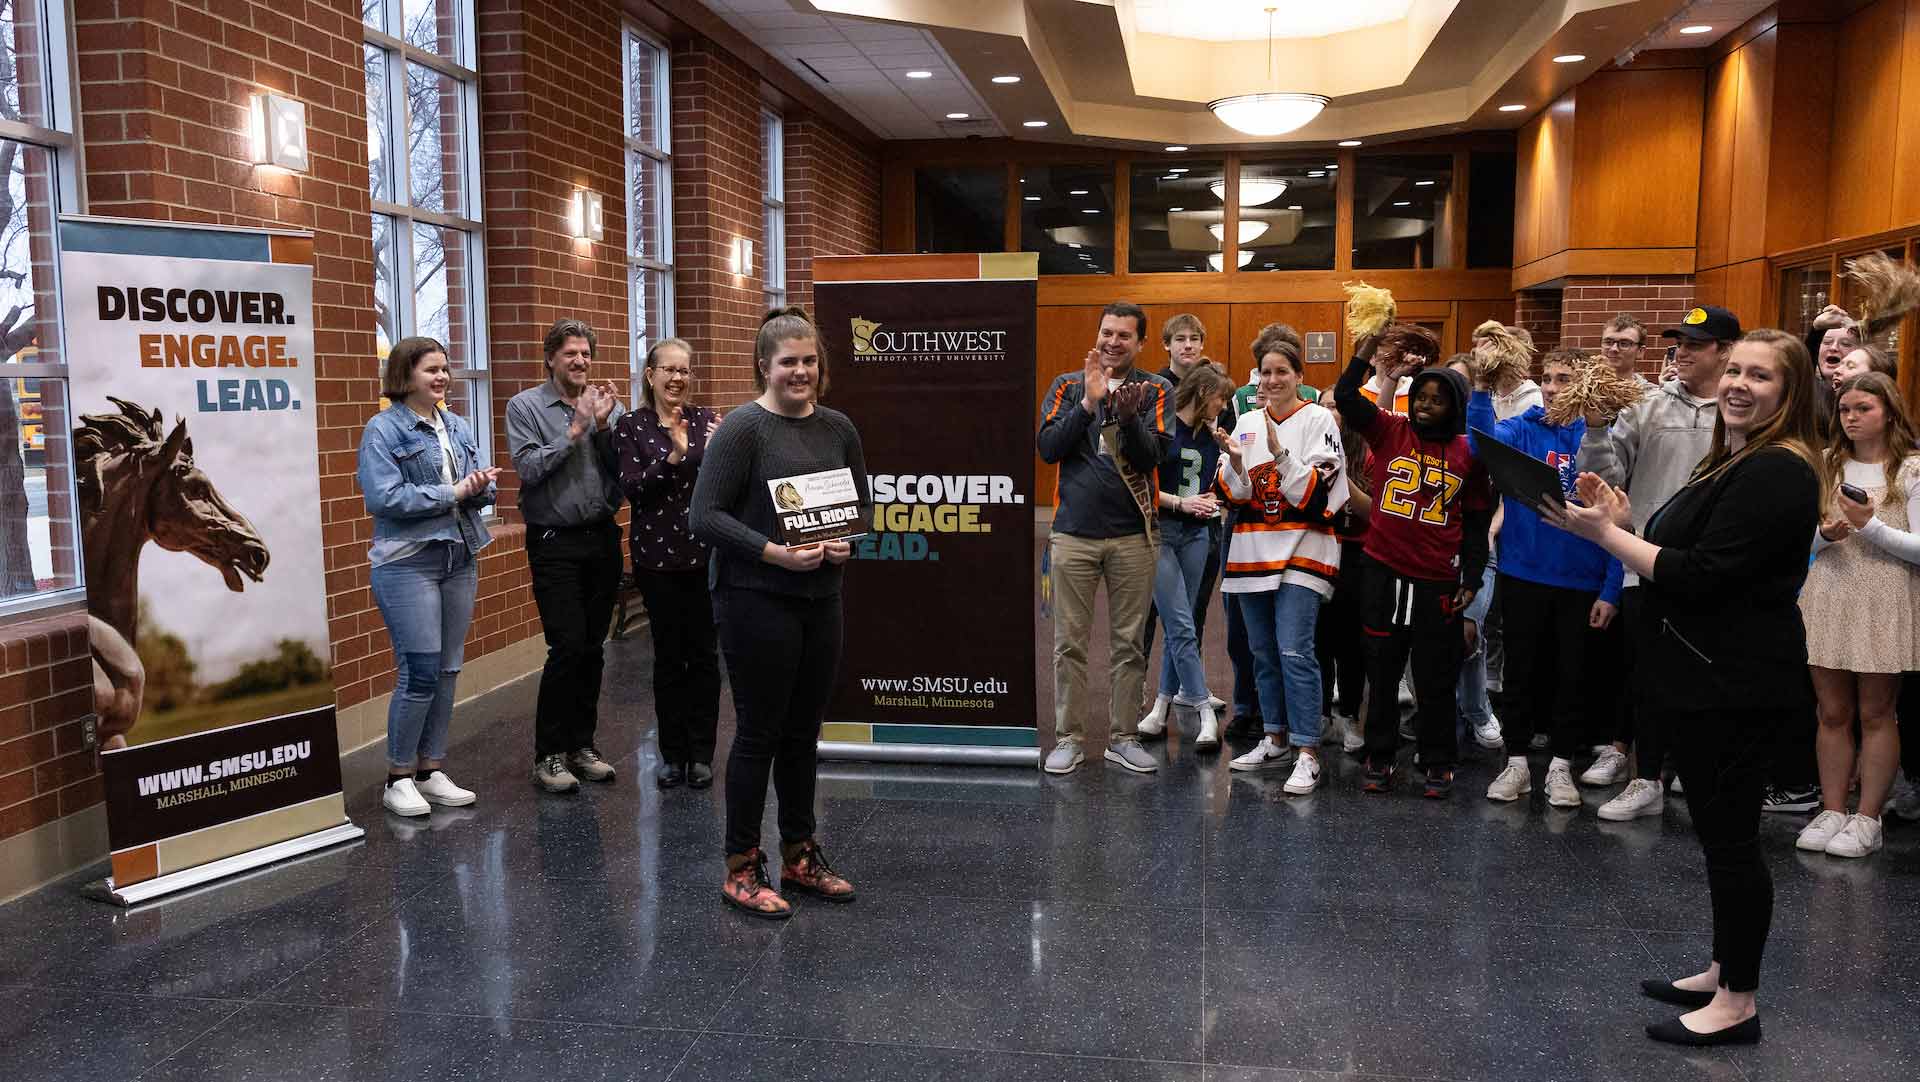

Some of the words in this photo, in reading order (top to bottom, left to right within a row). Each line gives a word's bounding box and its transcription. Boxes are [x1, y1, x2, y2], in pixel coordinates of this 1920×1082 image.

[97, 285, 296, 325] DISCOVER.
[138, 333, 299, 369] ENGAGE.
[852, 324, 1006, 352] SOUTHWEST
[946, 354, 1006, 362] UNIVERSITY
[196, 378, 302, 413] LEAD.
[1176, 447, 1204, 499] 3
[866, 474, 1025, 504] SCOVER.
[1379, 455, 1464, 527] 27
[783, 512, 820, 531] FULL
[820, 505, 859, 524] RIDE!
[872, 503, 992, 533] GAGE.
[850, 532, 940, 561] EAD.
[861, 676, 1008, 694] www.SMSU.edu
[874, 695, 929, 709] Marshall,
[931, 696, 994, 709] Minnesota
[138, 740, 311, 796] WWW.SMSU.EDU
[156, 785, 228, 810] MARSHALL,
[230, 766, 298, 792] MINNESOTA
